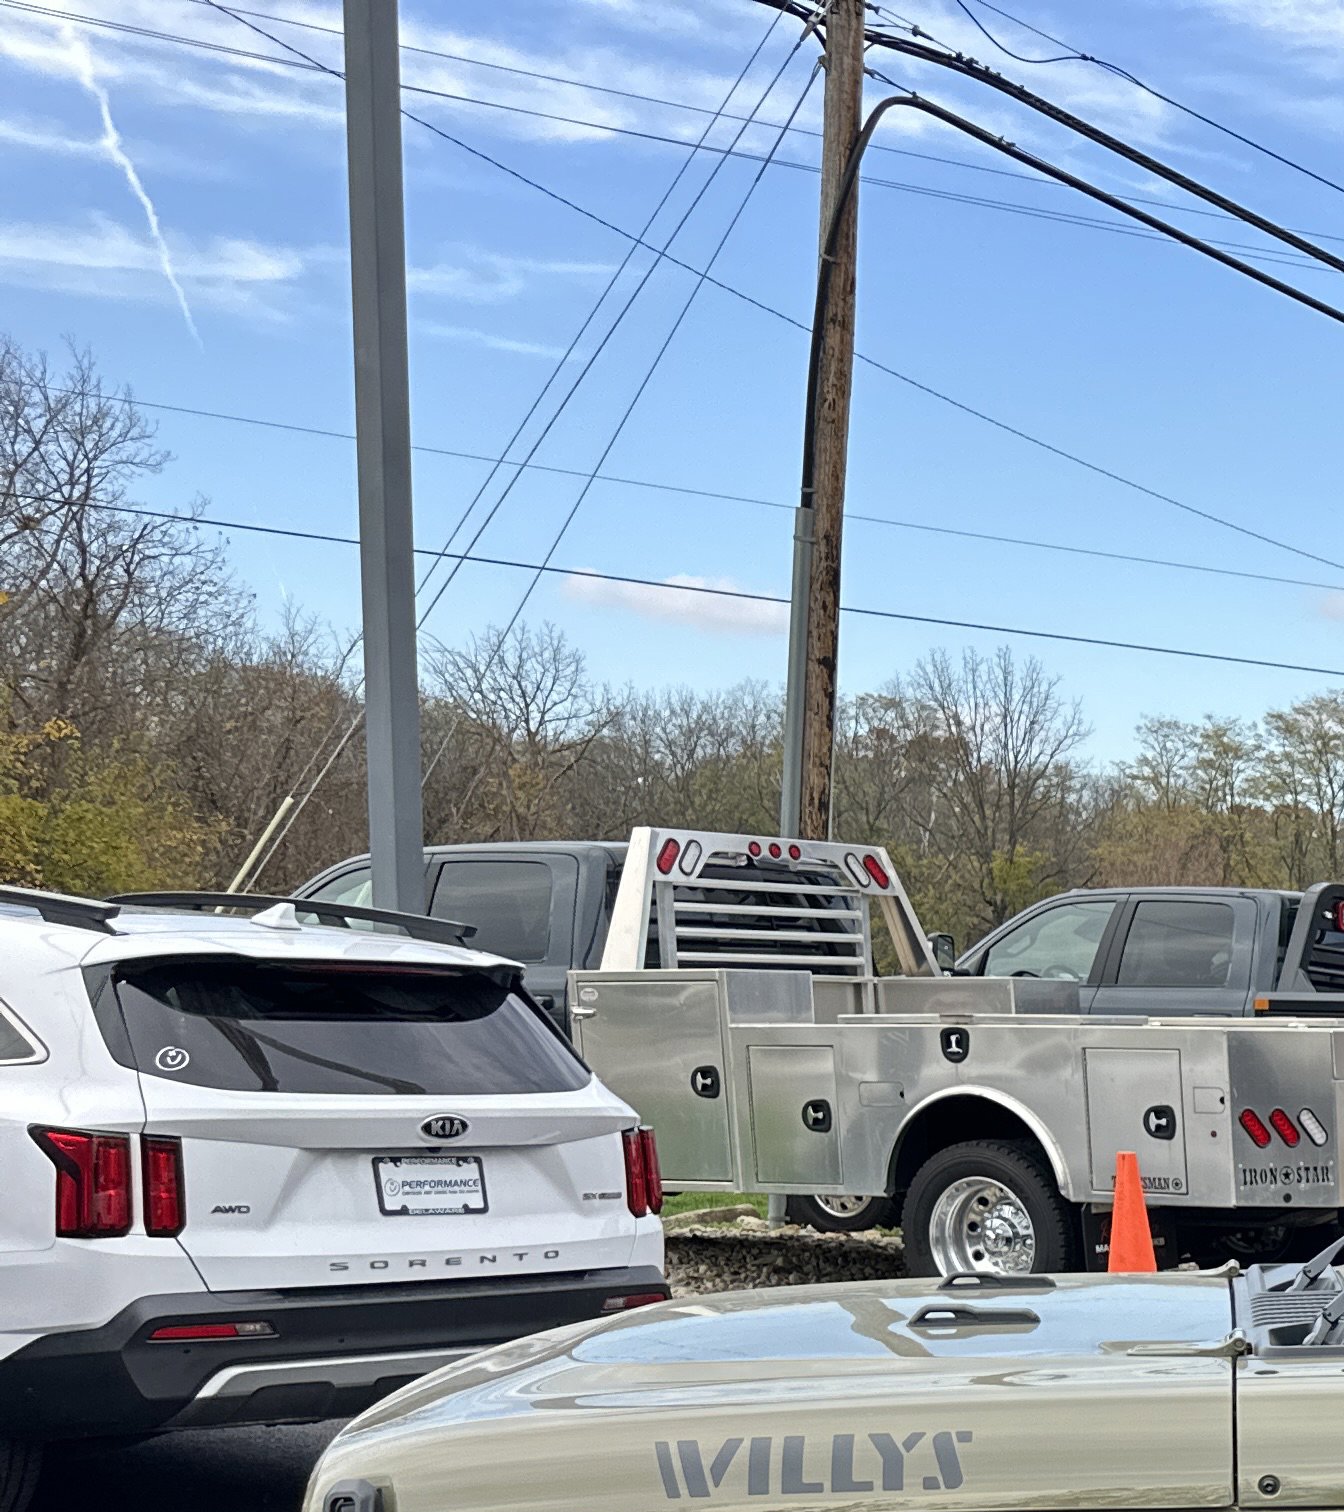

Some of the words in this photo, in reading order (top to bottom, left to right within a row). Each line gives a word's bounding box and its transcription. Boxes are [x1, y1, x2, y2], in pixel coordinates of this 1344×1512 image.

[430, 1119, 463, 1136] KIA
[402, 1179, 480, 1189] PERFORMANCE
[1242, 1168, 1278, 1186] IRON
[1296, 1165, 1330, 1183] STAR
[210, 1204, 251, 1214] AWD
[329, 1250, 560, 1272] SORENTO
[655, 1431, 973, 1499] WILLYS
